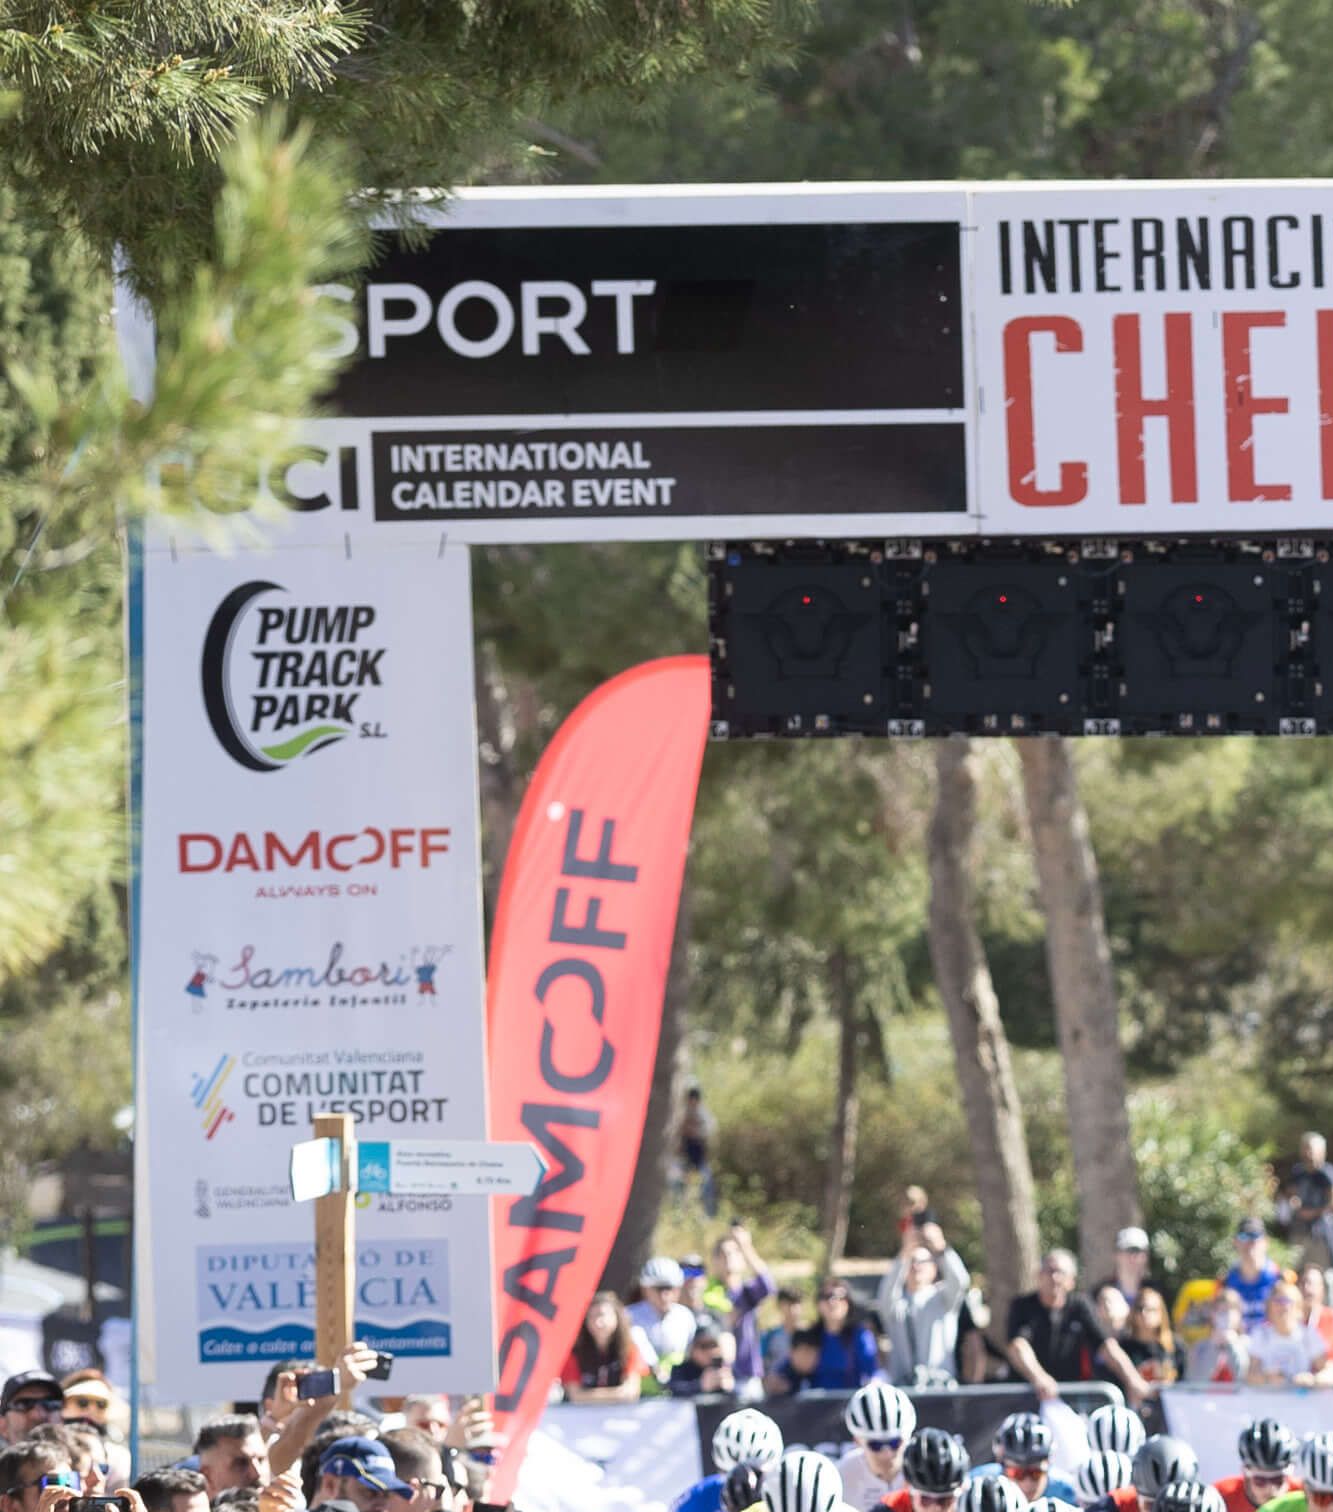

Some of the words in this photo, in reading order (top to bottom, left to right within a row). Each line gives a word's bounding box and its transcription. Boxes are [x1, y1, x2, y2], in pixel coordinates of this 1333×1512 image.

[305, 279, 656, 360] SPORT
[391, 441, 650, 474] INTERNATIONAL
[391, 479, 566, 510] CALENDAR
[572, 476, 677, 508] EVENT
[255, 605, 375, 645] PUMP
[252, 648, 388, 688] TRACK
[251, 693, 361, 733] PARK
[242, 1051, 329, 1067] Comunitat
[334, 1049, 424, 1065] Valenciana
[244, 1070, 424, 1097] COMUNITAT
[258, 1103, 298, 1126] DE
[395, 1247, 434, 1266] DE
[208, 1274, 438, 1312] VALÈCIA
